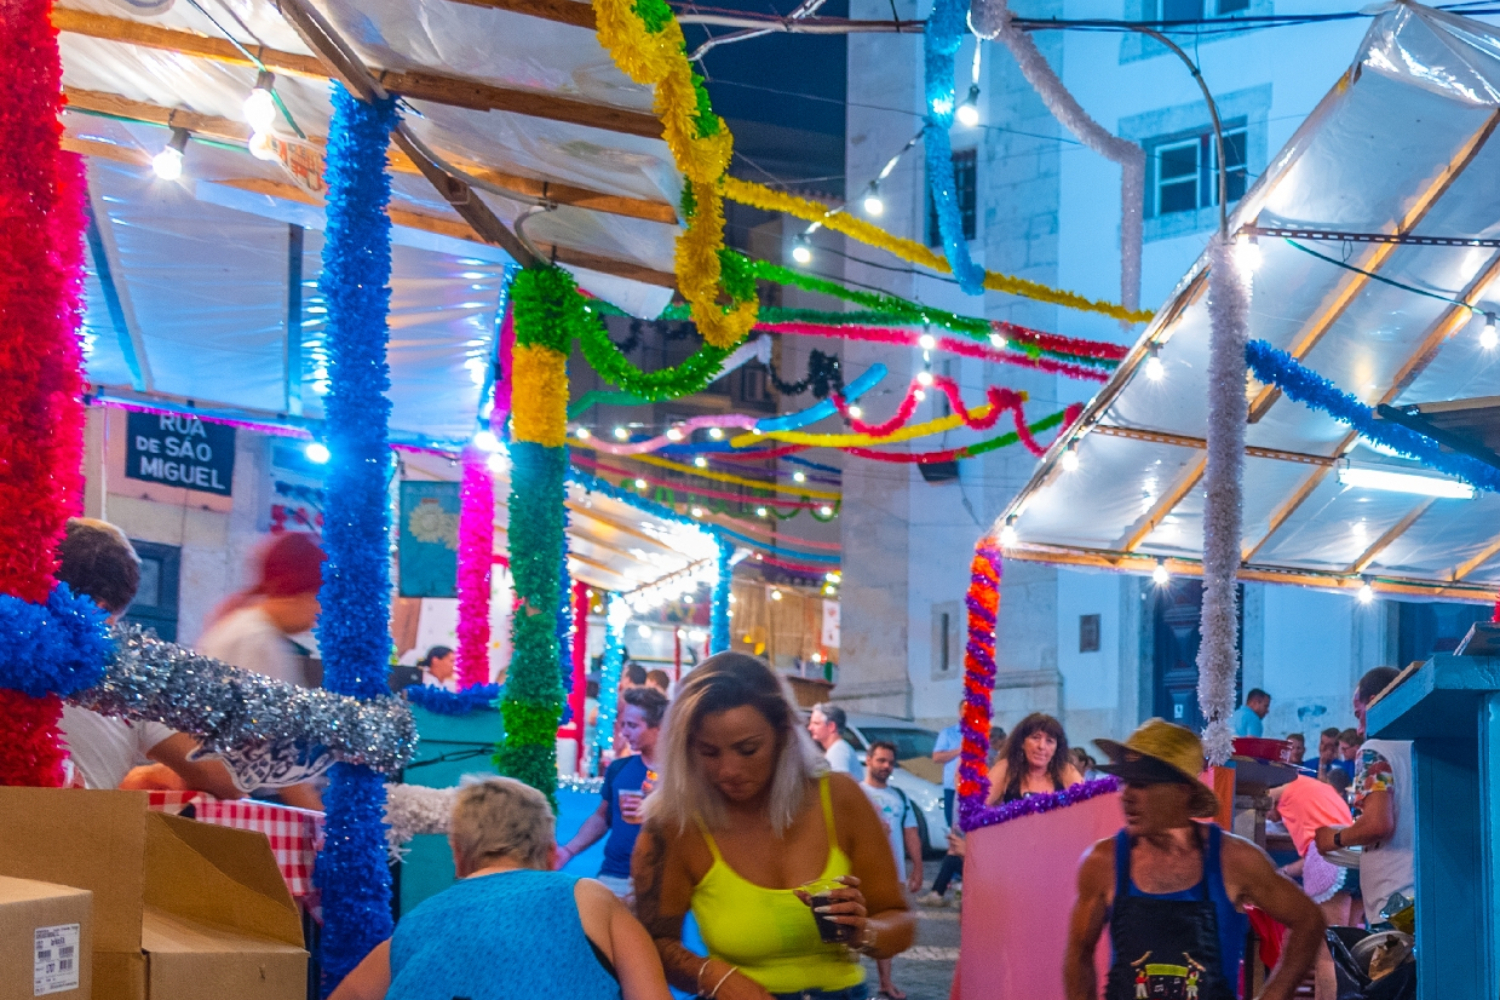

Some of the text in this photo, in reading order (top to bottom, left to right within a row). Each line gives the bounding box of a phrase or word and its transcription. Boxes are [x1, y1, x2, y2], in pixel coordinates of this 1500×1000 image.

[160, 412, 207, 437] RUA
[136, 435, 161, 454] DE
[140, 456, 226, 490] MIGUEL
